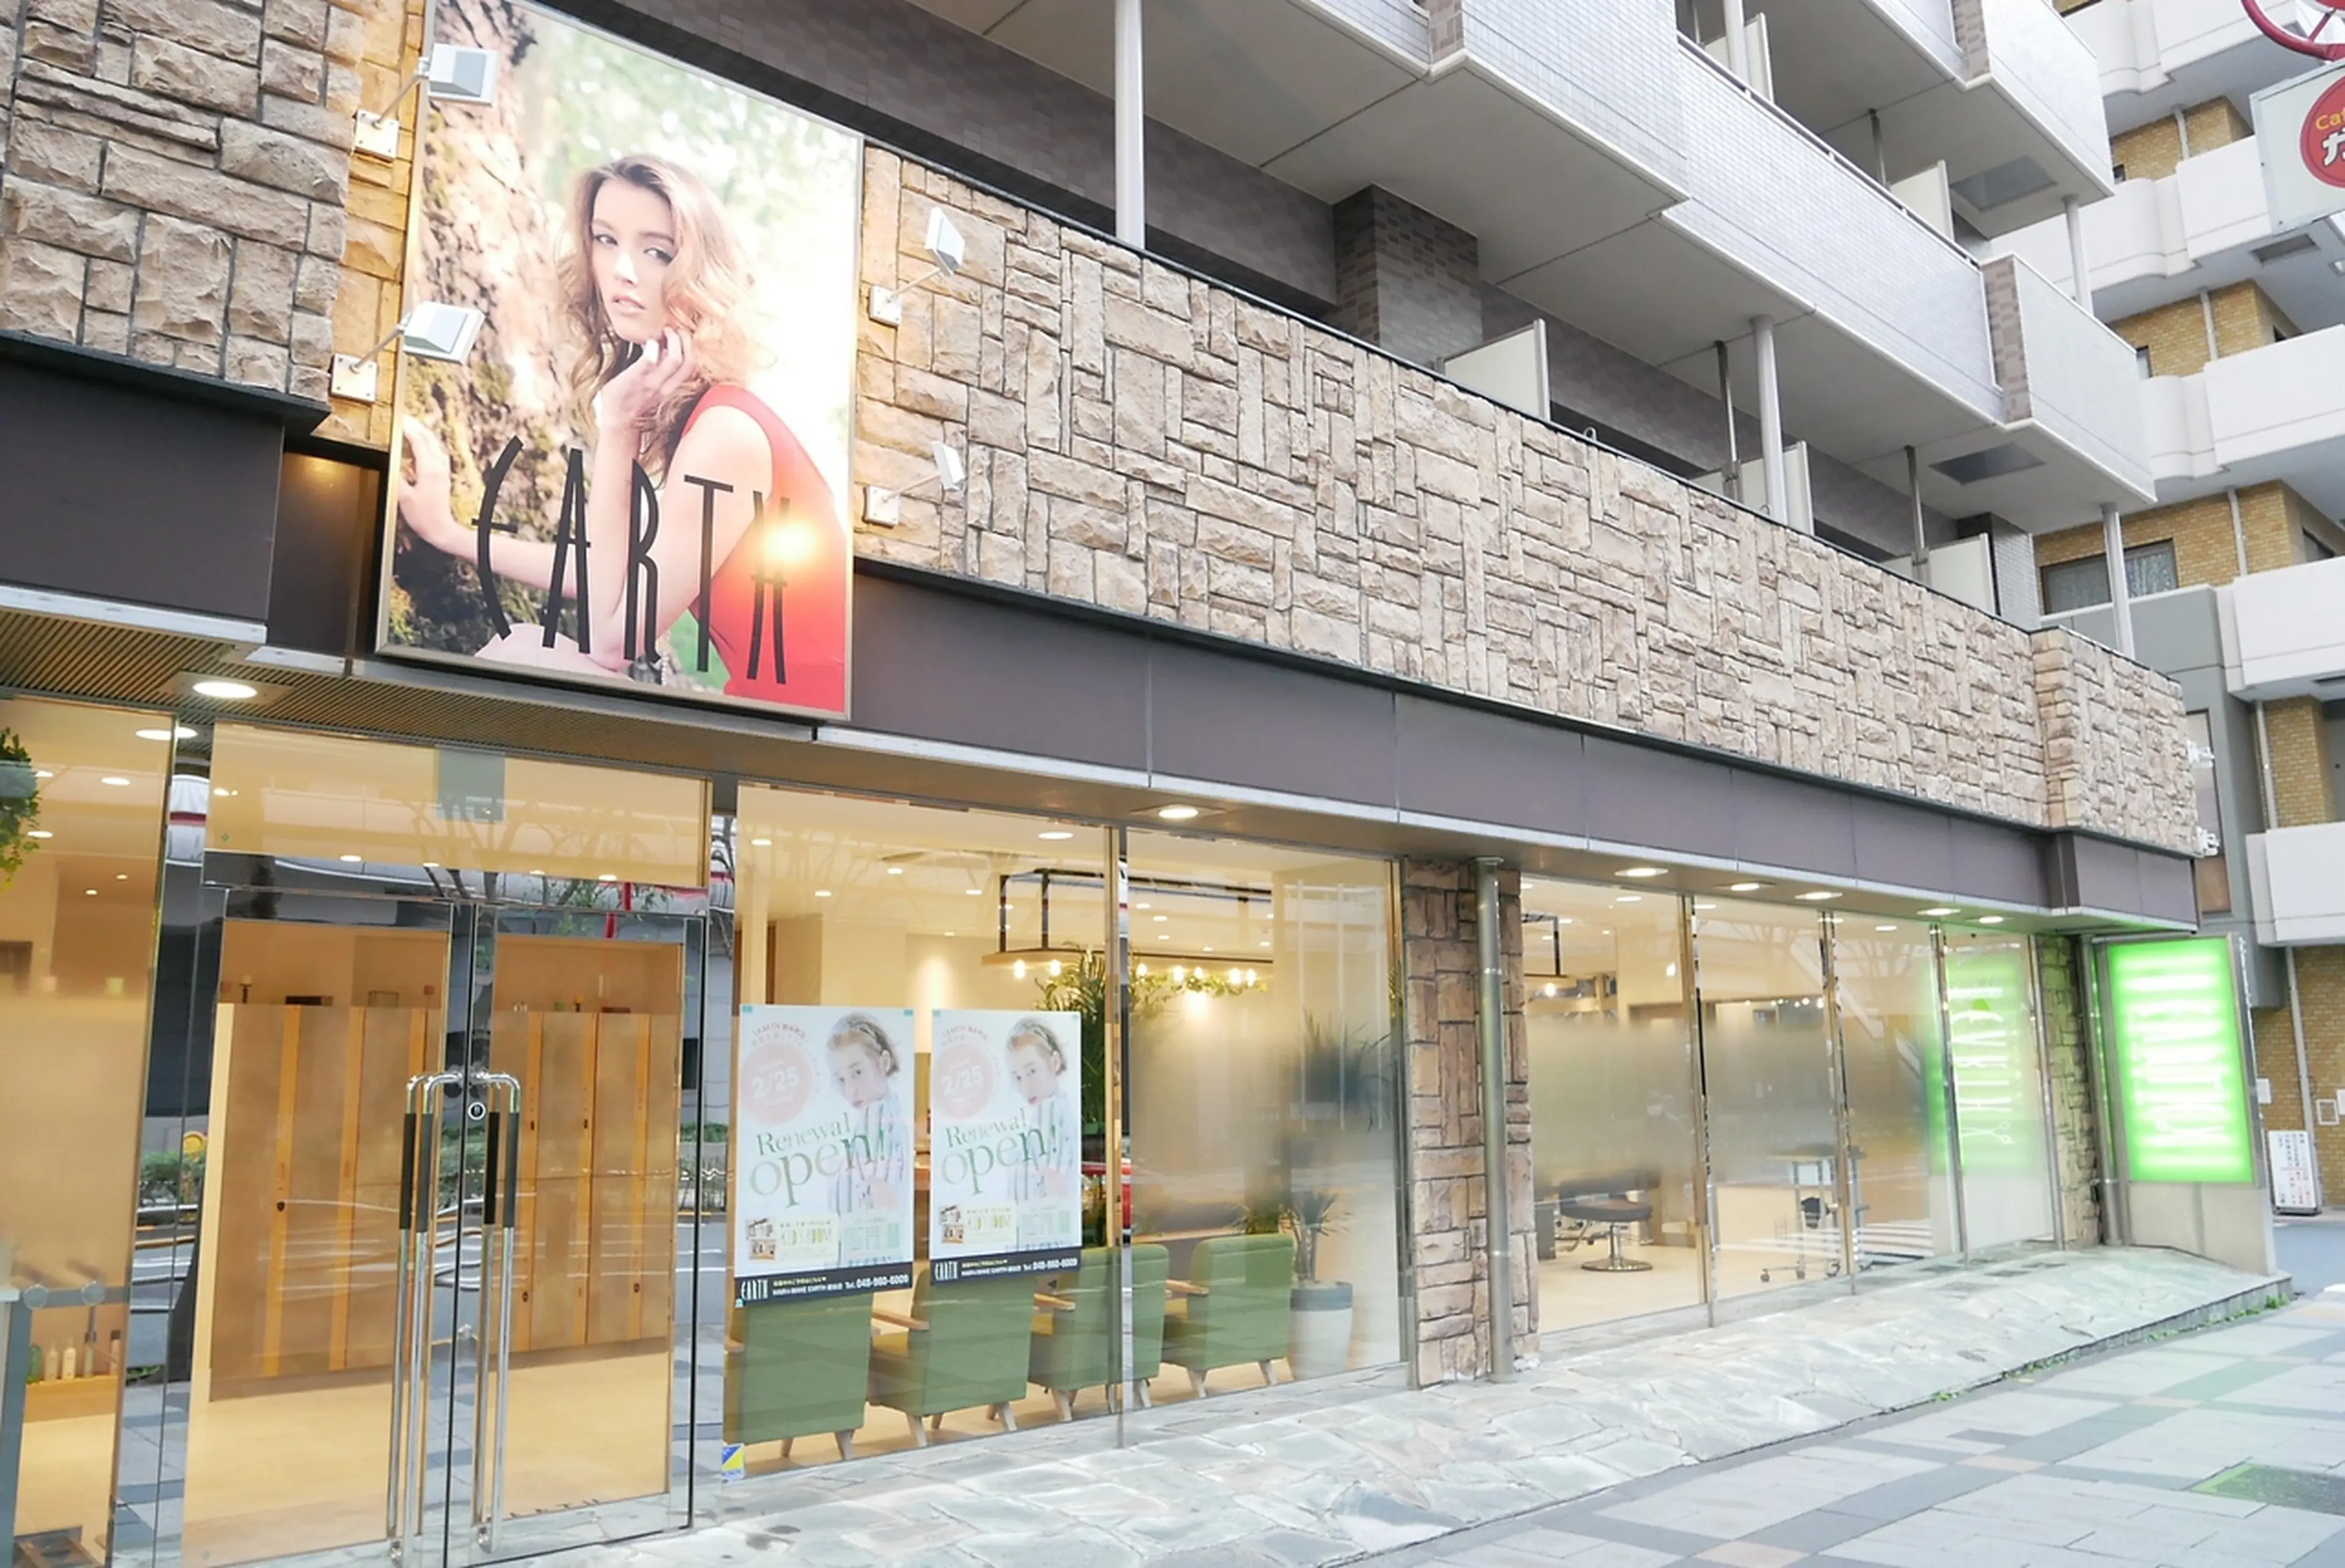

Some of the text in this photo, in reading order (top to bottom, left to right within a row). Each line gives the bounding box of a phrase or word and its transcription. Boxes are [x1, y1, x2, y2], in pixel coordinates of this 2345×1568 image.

[471, 435, 790, 684] EARTH
[751, 1065, 799, 1098] 2/25
[940, 1065, 984, 1095] 2/25
[756, 1111, 851, 1156] Renewal
[945, 1107, 1027, 1148] Renewal
[749, 1128, 885, 1208] open!
[941, 1123, 1057, 1197] open!
